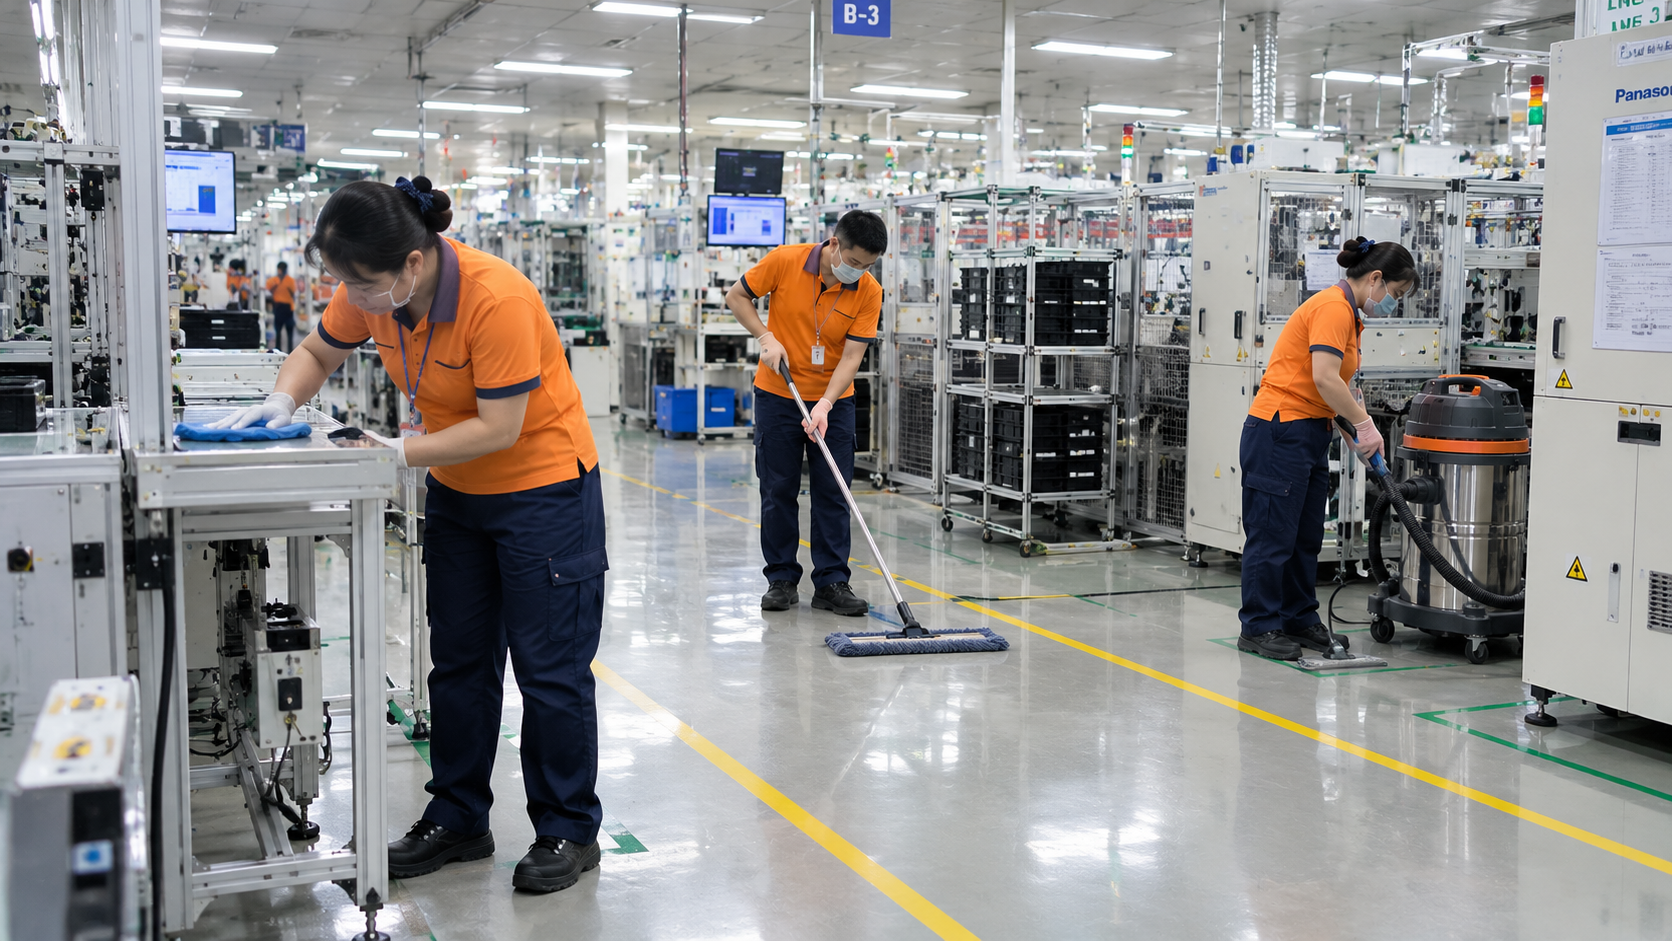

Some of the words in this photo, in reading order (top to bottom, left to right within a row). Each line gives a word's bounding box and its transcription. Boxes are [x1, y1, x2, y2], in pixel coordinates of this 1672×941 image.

[844, 3, 879, 26] B-3
[1649, 6, 1660, 24] 3
[1615, 85, 1672, 104] Panaso
